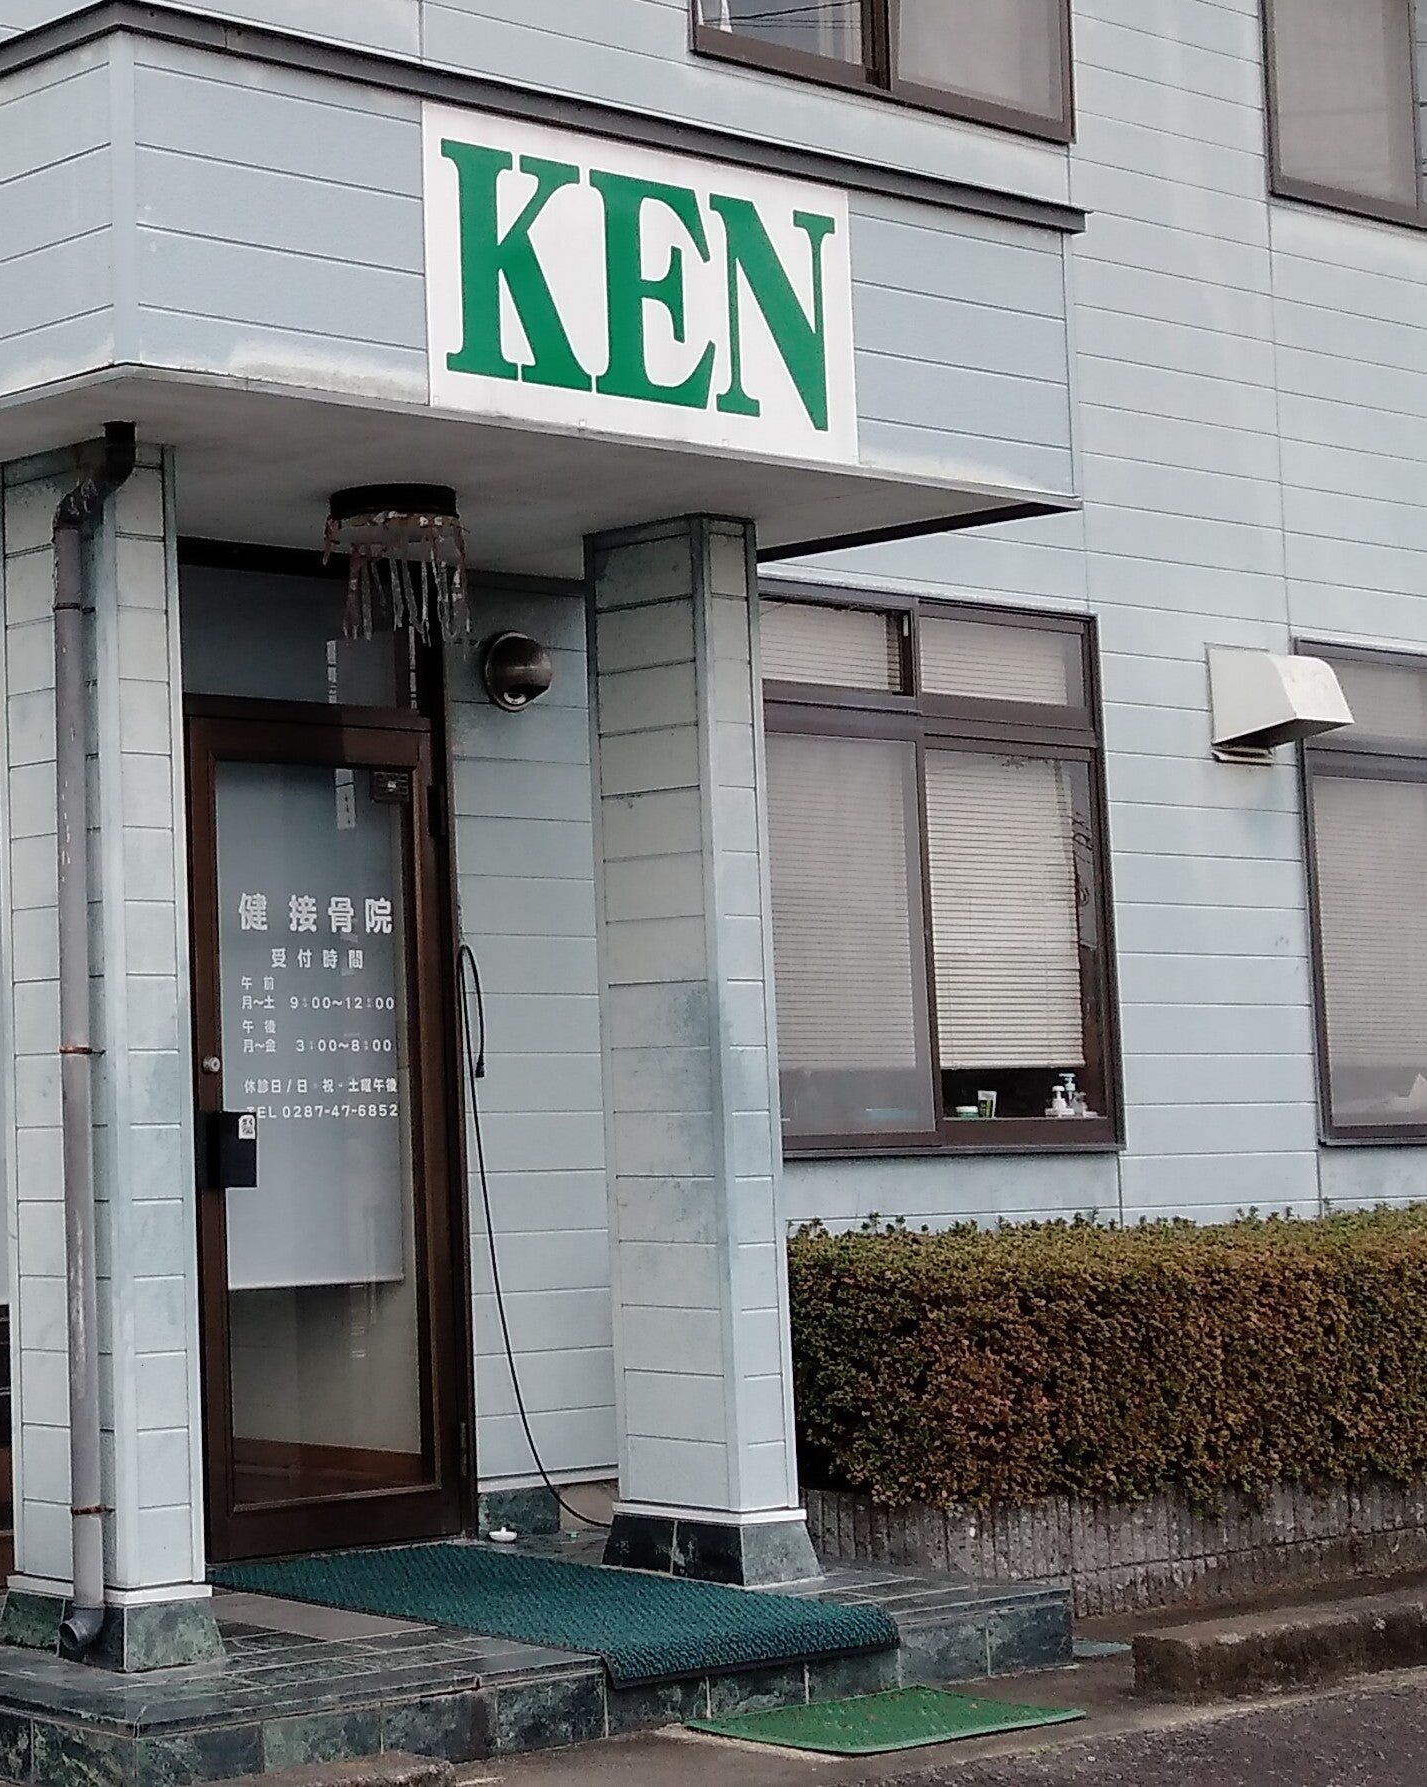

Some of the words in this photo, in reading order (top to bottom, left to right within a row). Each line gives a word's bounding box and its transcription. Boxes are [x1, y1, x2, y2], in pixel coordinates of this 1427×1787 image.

[441, 138, 835, 431] KEN
[271, 948, 363, 969] 受付時間
[282, 1105, 398, 1118] 0287-47-6852
